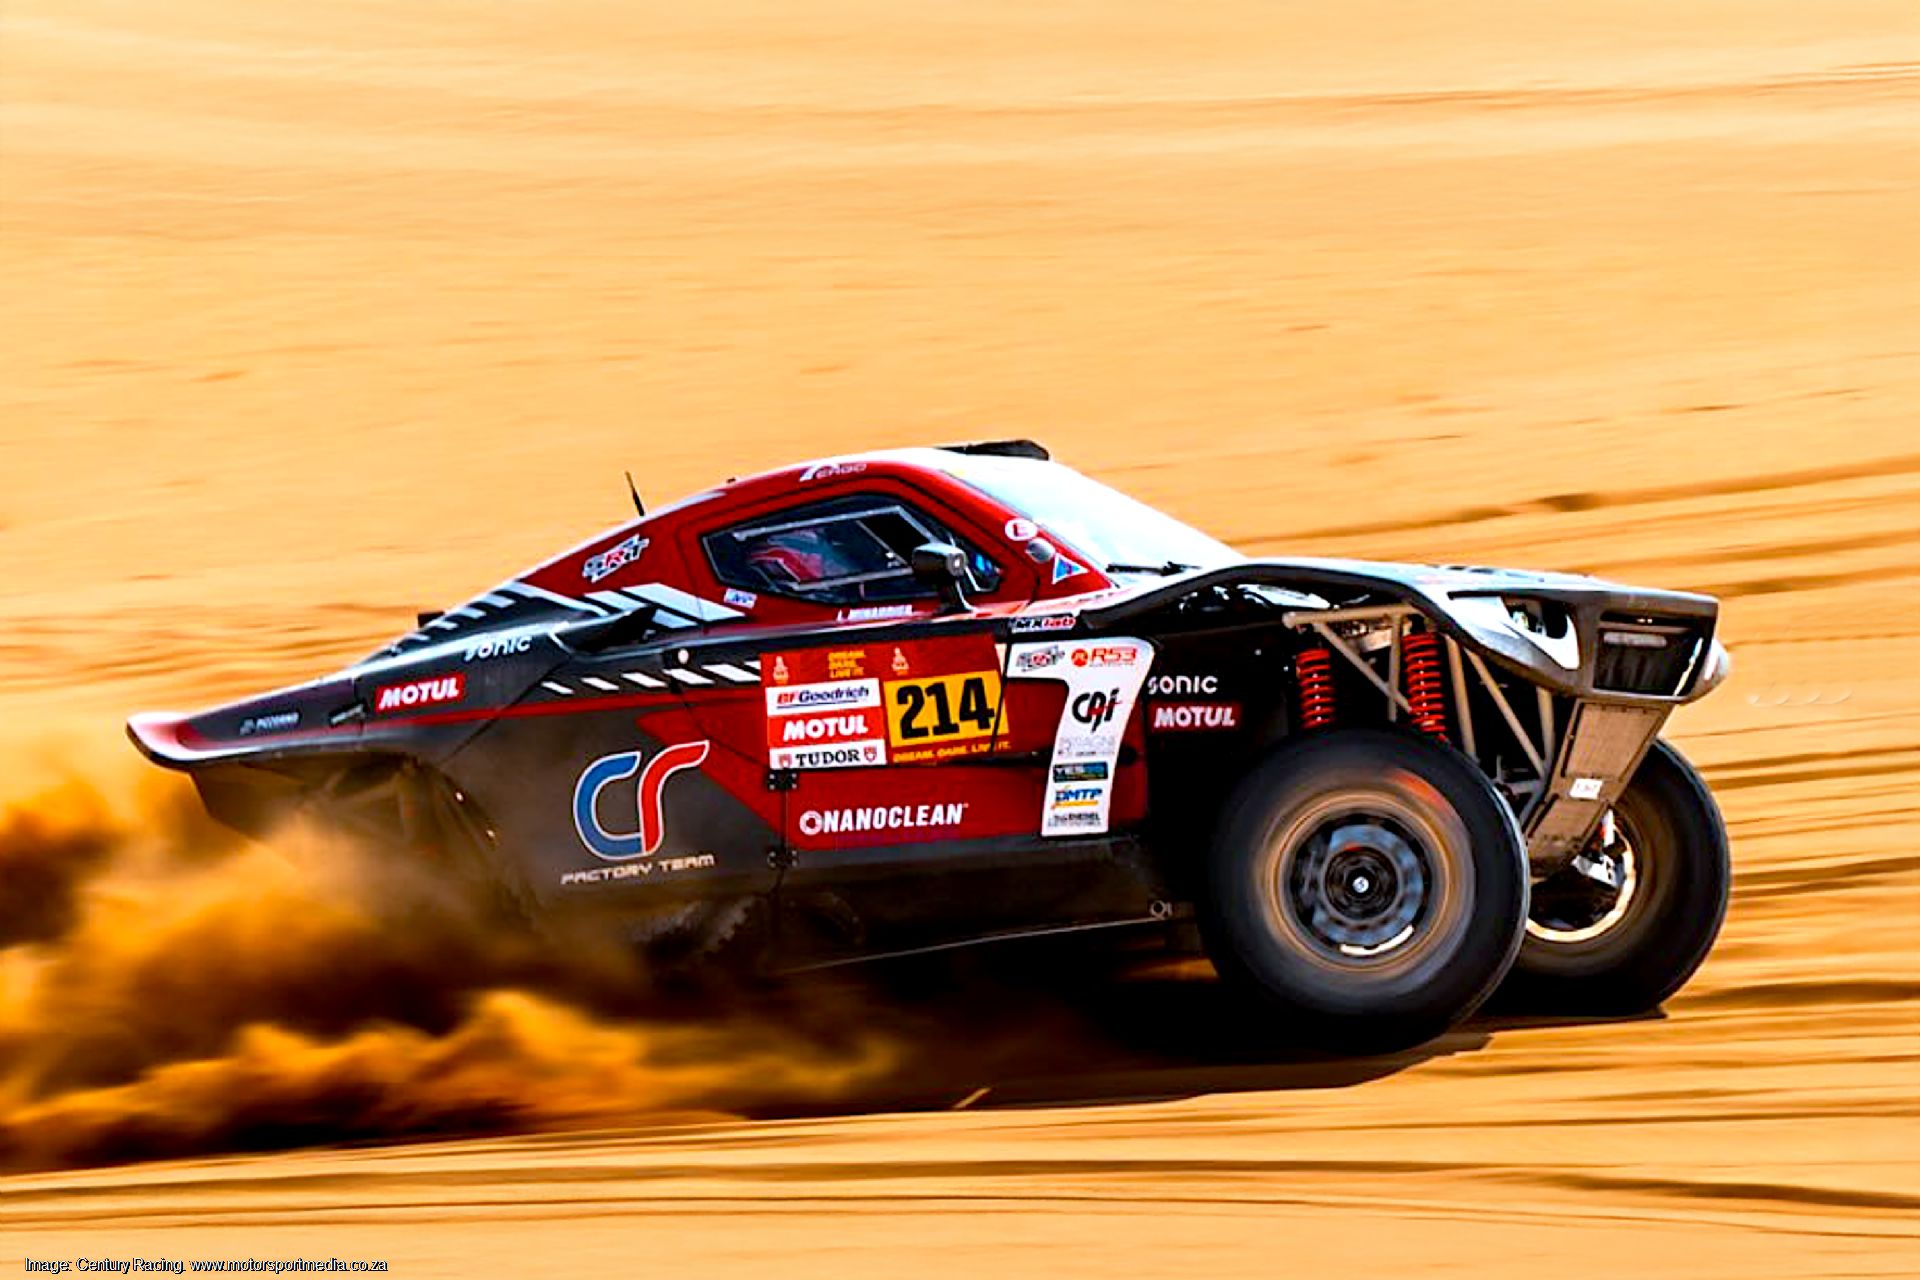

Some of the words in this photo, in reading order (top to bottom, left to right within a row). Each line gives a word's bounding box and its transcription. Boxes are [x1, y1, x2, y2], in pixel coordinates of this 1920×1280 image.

[378, 677, 459, 710] MOTUL
[897, 677, 995, 739] 214
[783, 714, 868, 742] MOTUL
[1154, 706, 1236, 728] MOTUL
[795, 749, 861, 767] TUDOR
[561, 862, 653, 885] FACTORY
[657, 854, 715, 873] TEAM
